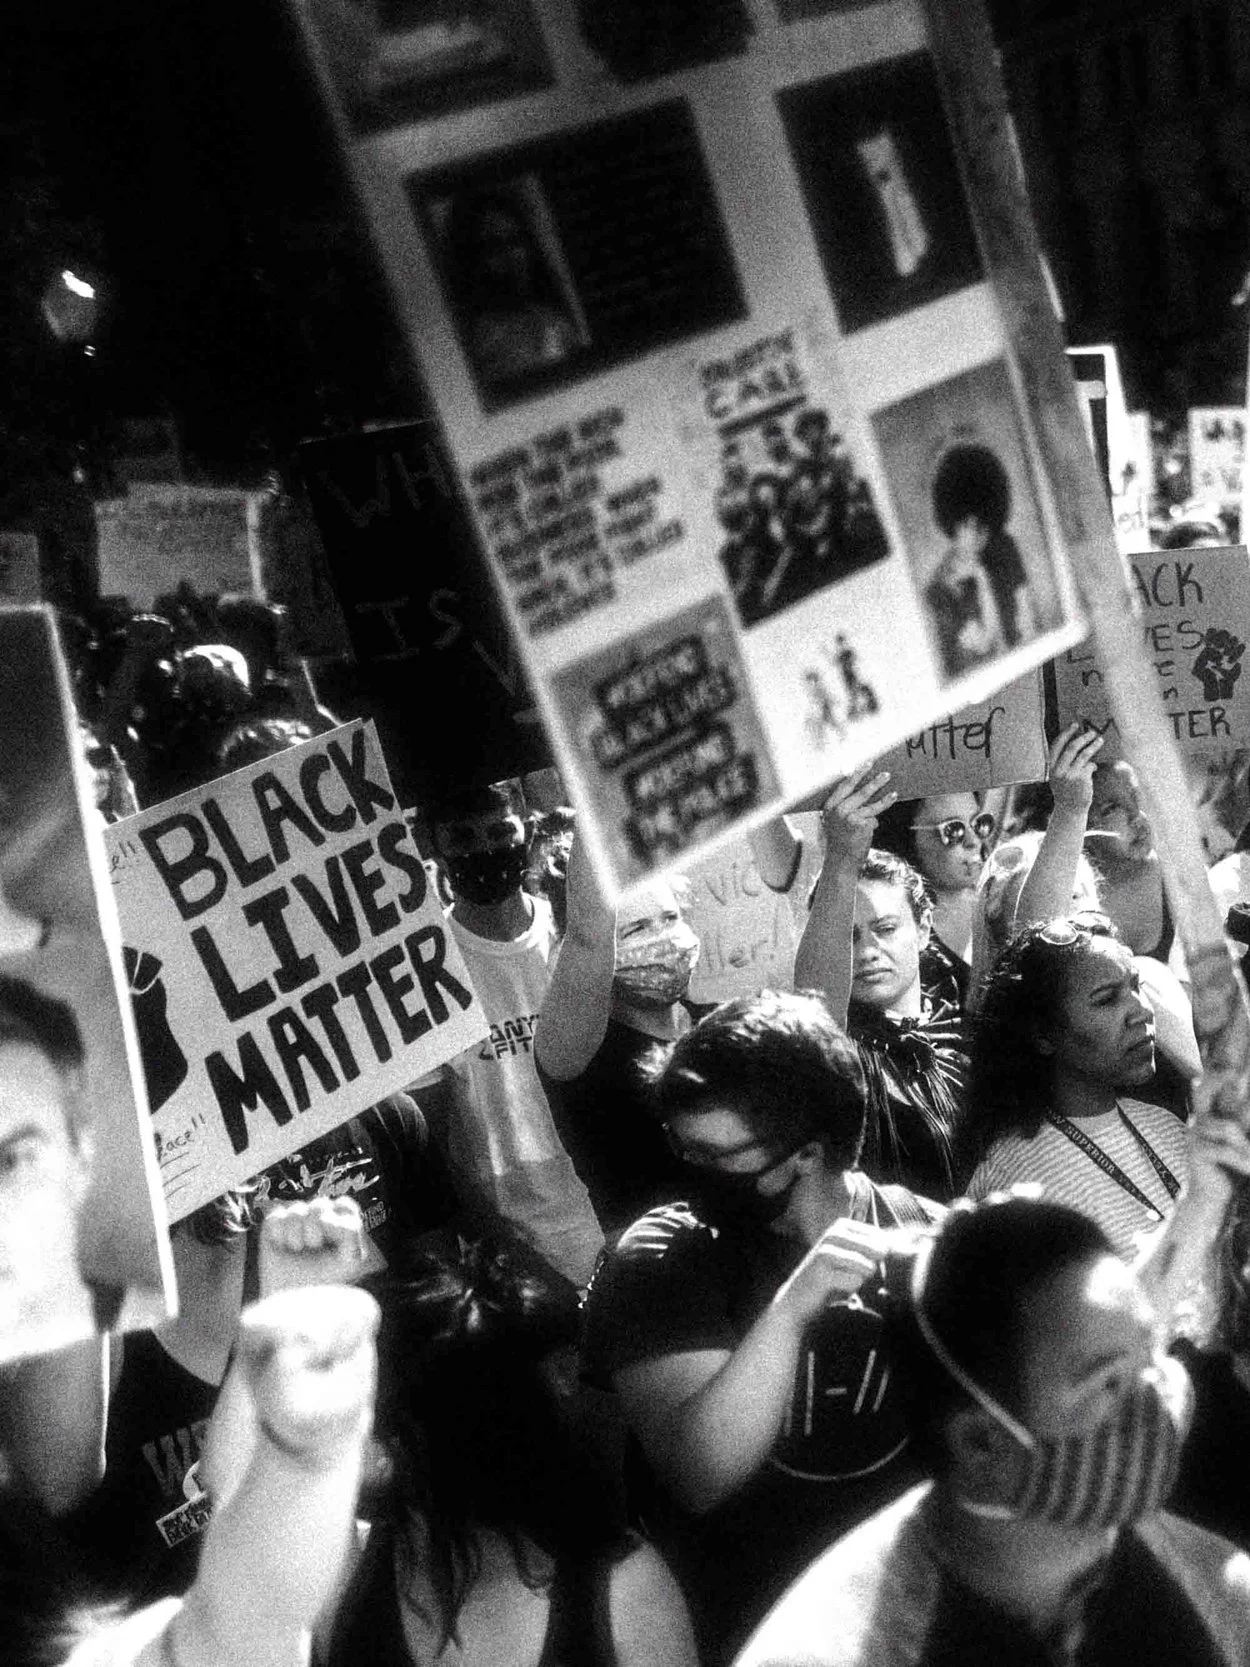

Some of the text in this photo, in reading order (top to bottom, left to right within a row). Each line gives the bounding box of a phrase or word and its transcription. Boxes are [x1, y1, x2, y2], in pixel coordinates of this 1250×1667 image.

[138, 730, 396, 921] BLACK
[190, 821, 428, 1022] LIVES
[204, 925, 473, 1155] MATTER
[1064, 1123, 1117, 1174] SUPERIOR
